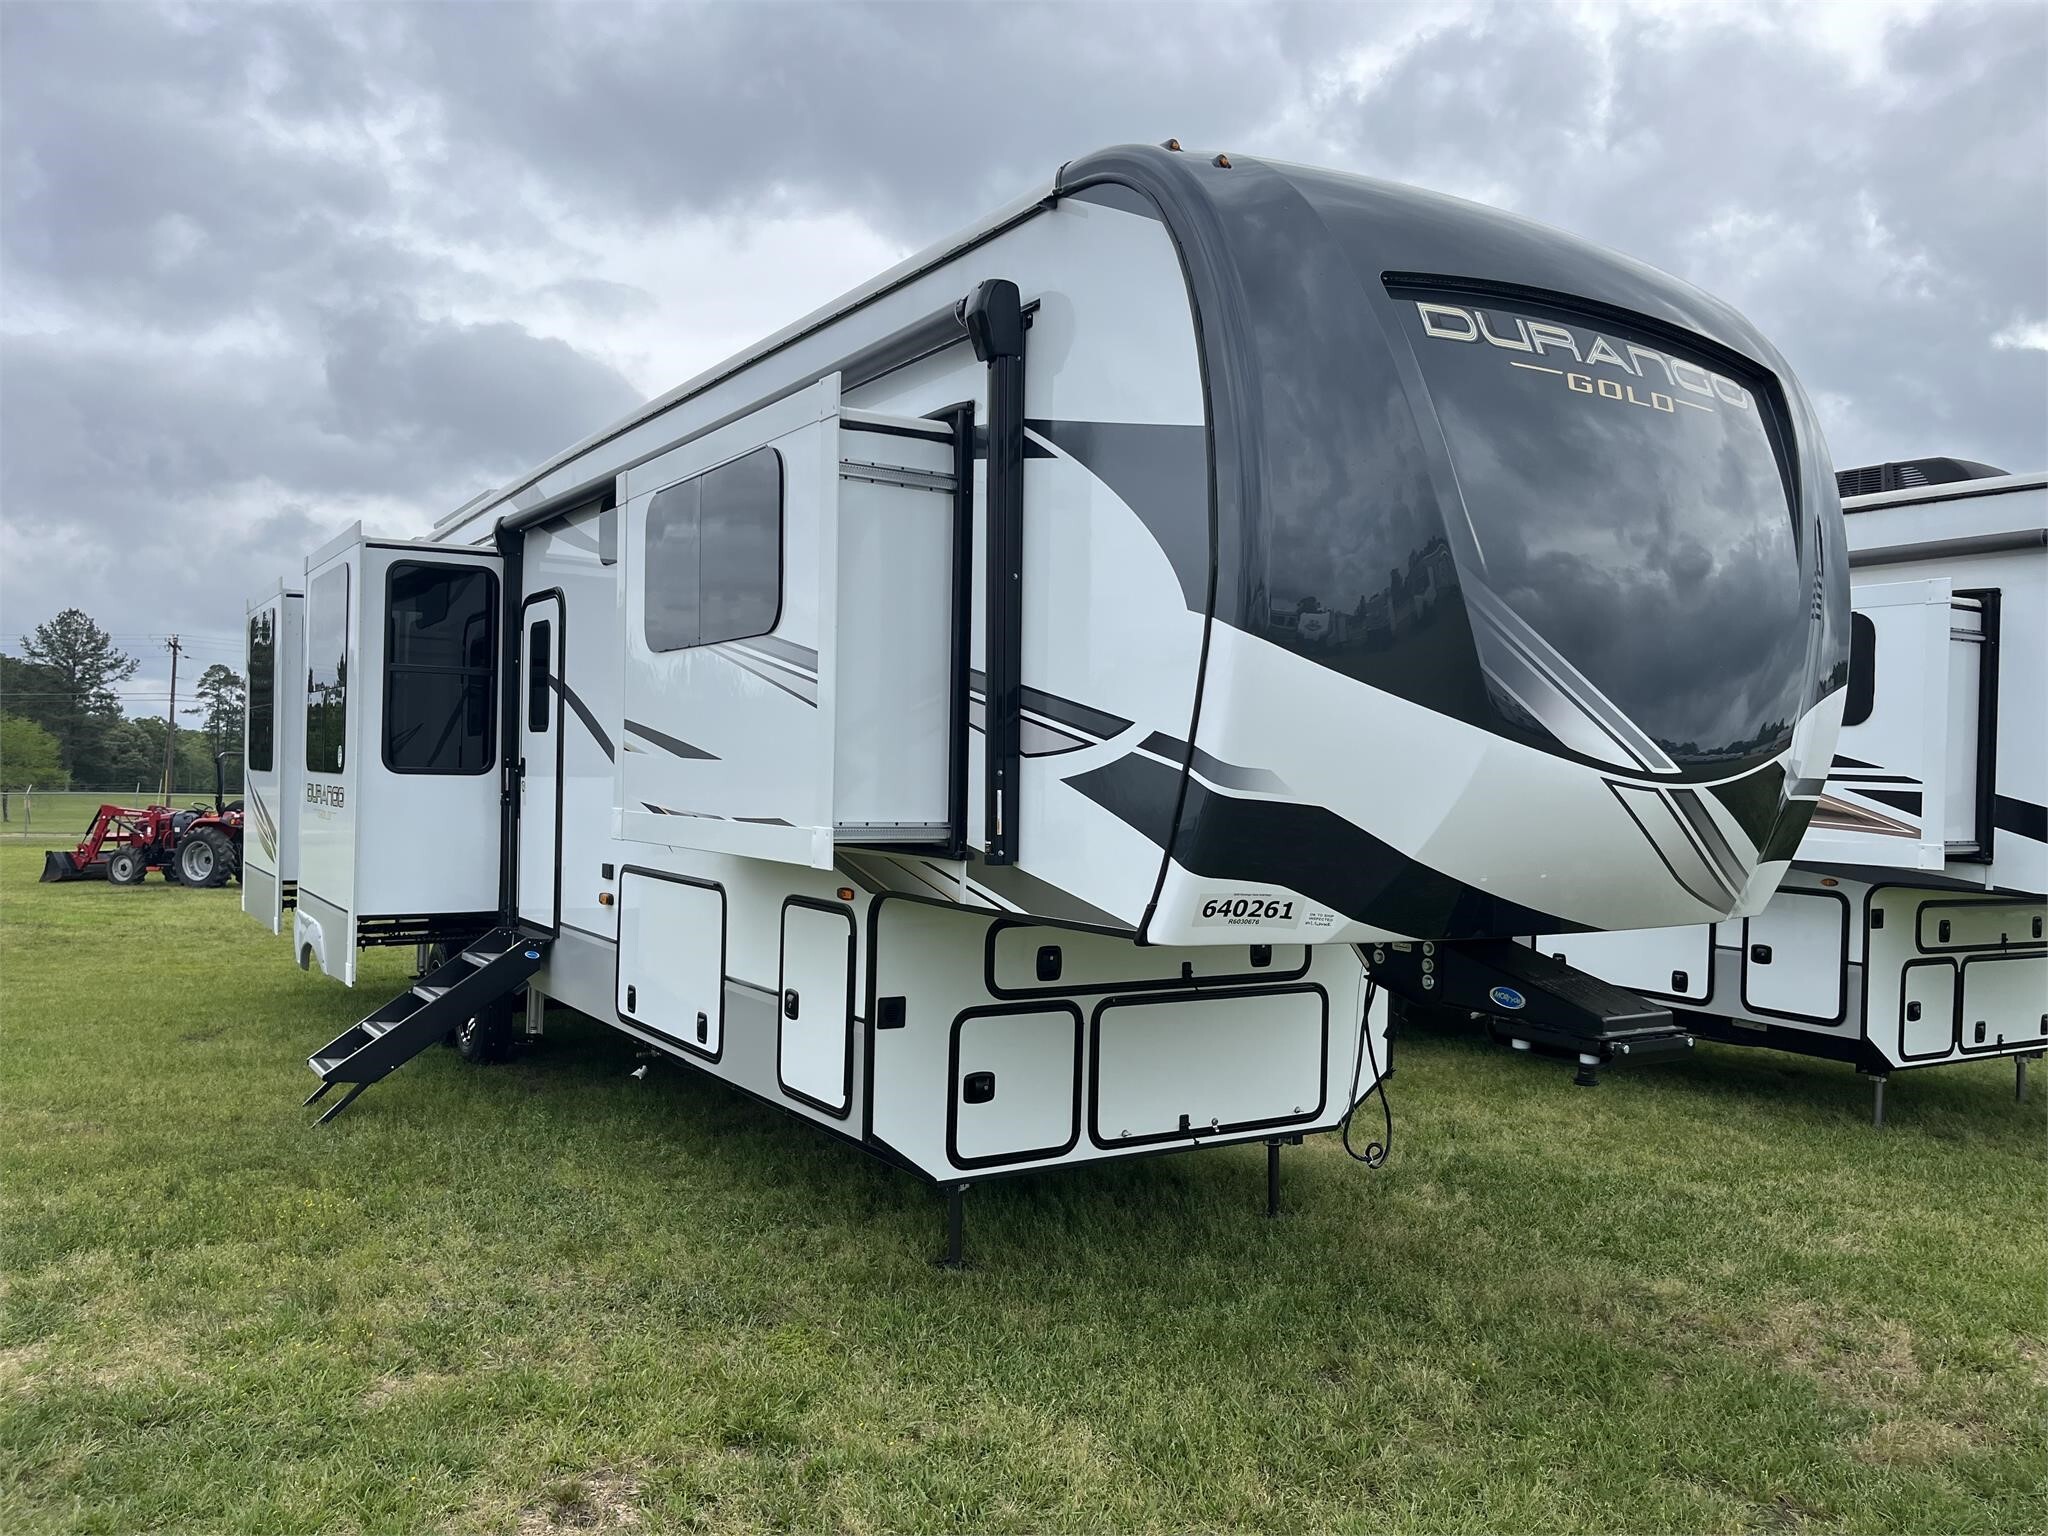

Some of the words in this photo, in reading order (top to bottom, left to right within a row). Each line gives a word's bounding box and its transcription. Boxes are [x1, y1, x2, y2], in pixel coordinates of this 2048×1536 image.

[1414, 301, 1749, 409] DURANGO
[1567, 372, 1674, 413] GOLD
[1202, 900, 1294, 920] 640261
